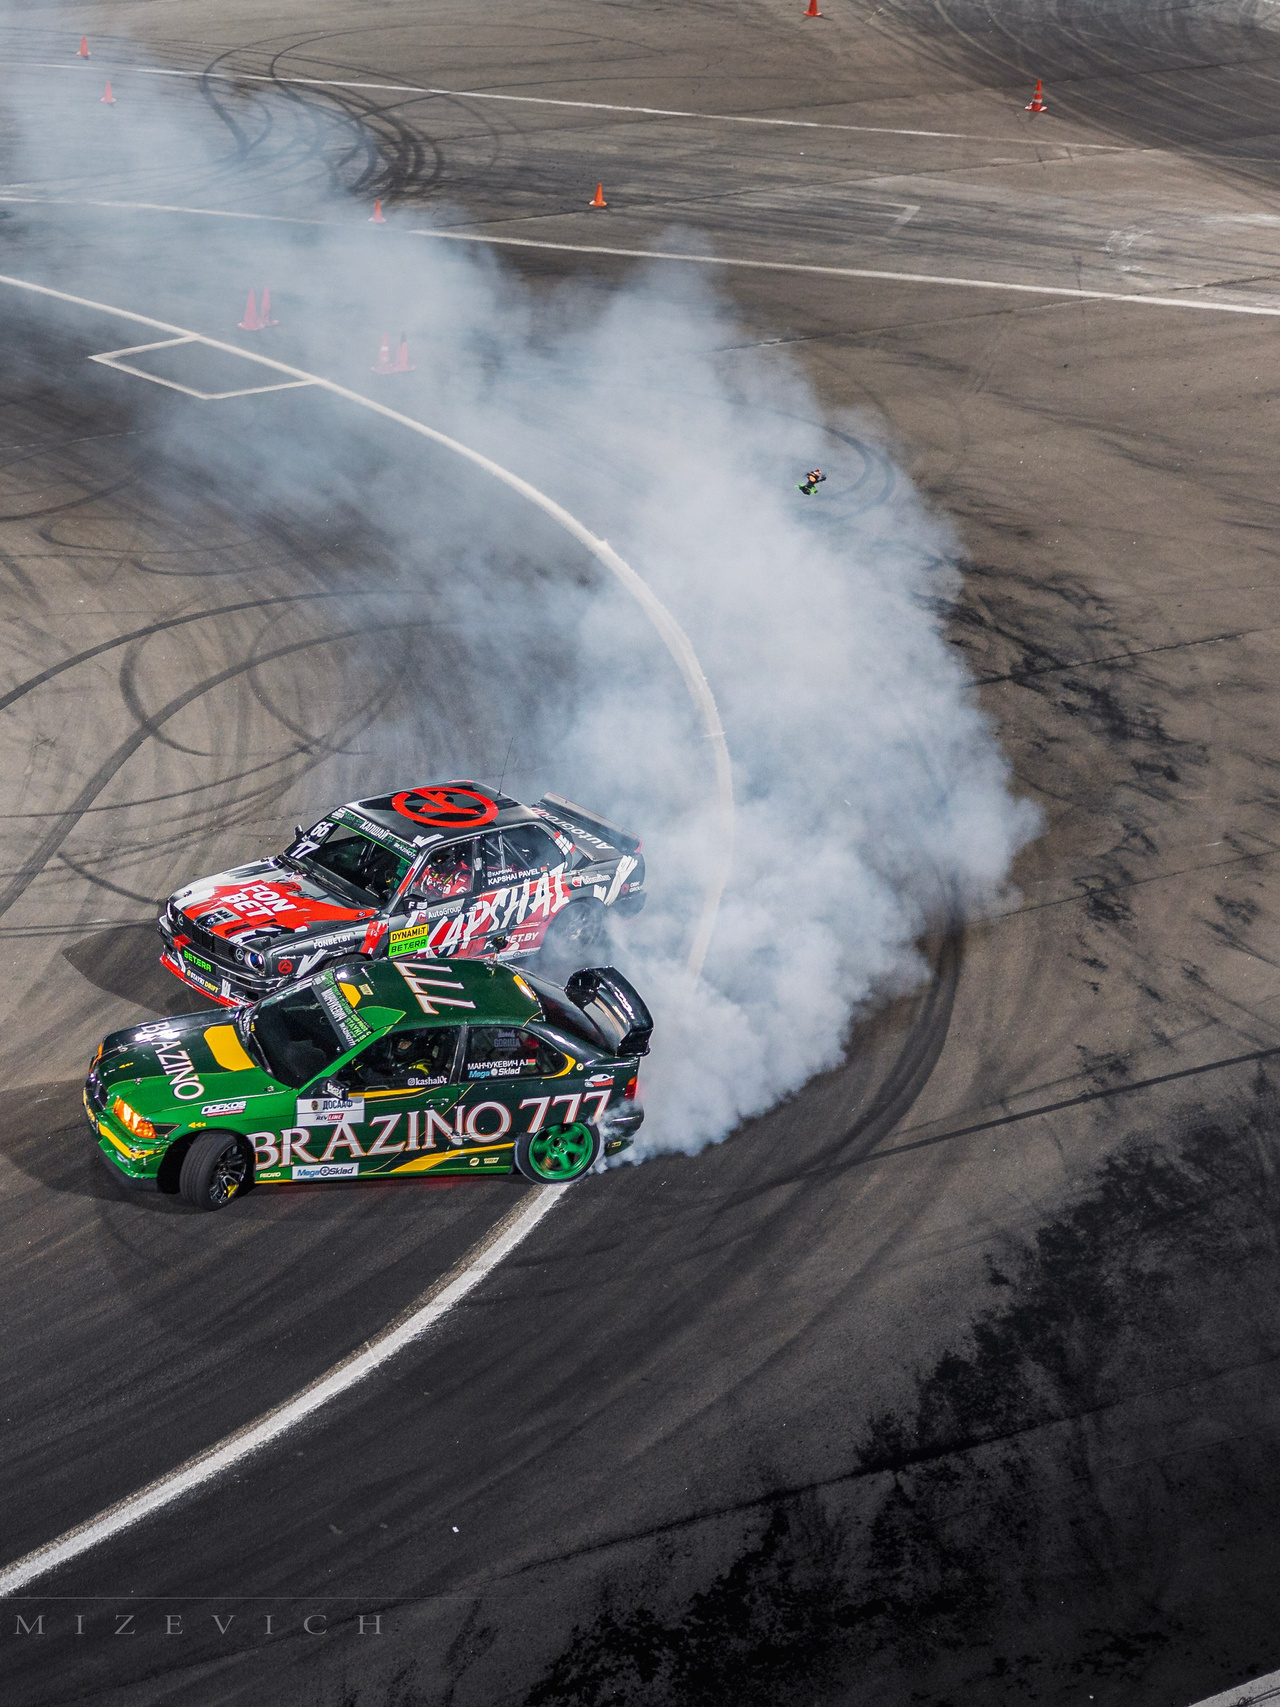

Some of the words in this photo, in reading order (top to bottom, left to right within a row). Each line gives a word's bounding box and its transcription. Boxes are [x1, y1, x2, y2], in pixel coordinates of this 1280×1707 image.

[310, 821, 334, 838] 66
[487, 872, 518, 886] KAPSHAI
[517, 868, 540, 879] PAVEL
[239, 884, 297, 912] FON
[220, 894, 276, 918] BET
[428, 905, 462, 920] AutoGroup
[313, 934, 351, 949] FONBET.BY
[204, 980, 219, 993] DRIFT
[393, 961, 477, 1015] 777
[467, 1059, 519, 1070] МАНЧУКЕВИЧ
[498, 1066, 521, 1076] Sklad
[322, 1099, 353, 1111] ДОСААФ
[245, 1100, 513, 1171] BRAZINO
[518, 1089, 612, 1134] 777
[297, 1168, 321, 1178] Mega
[329, 1166, 355, 1176] Sklad
